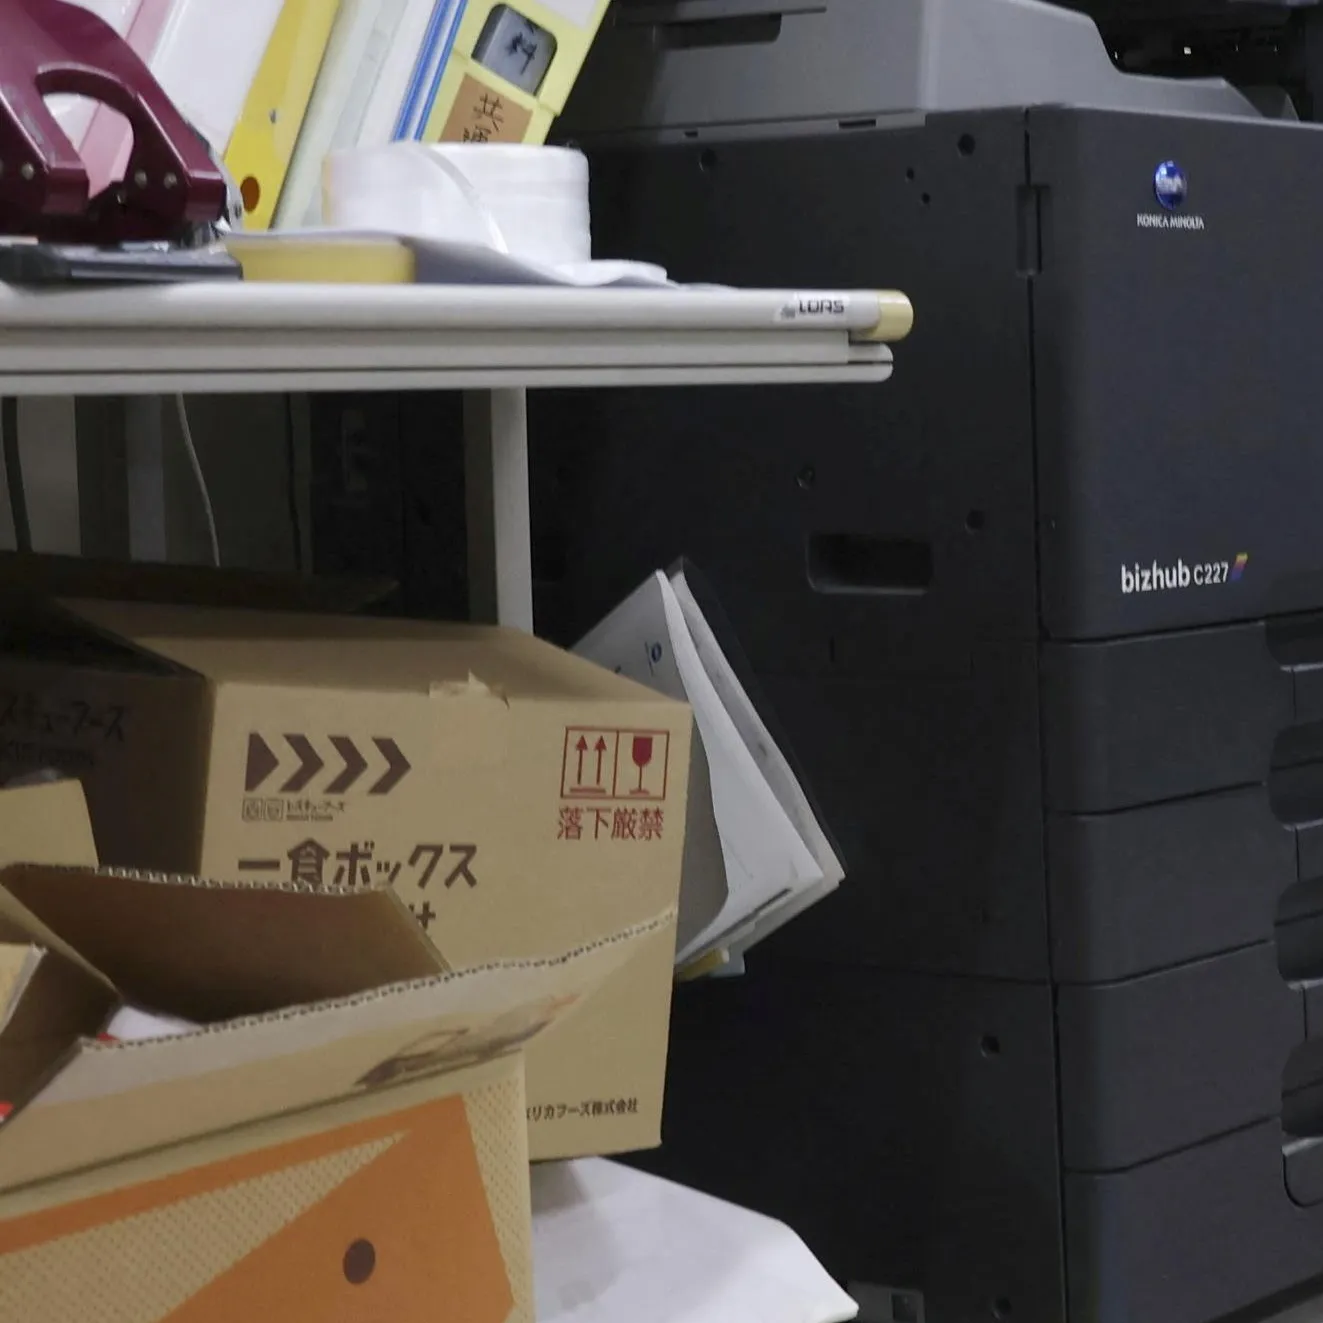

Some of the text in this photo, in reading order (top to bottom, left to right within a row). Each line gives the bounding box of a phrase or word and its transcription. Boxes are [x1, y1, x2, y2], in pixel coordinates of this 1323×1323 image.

[1136, 213, 1205, 230] KONICA MINOLTA
[1121, 558, 1229, 594] bizhub C227
[557, 806, 664, 841] 落下厳禁
[237, 837, 478, 890] 一食ボックス
